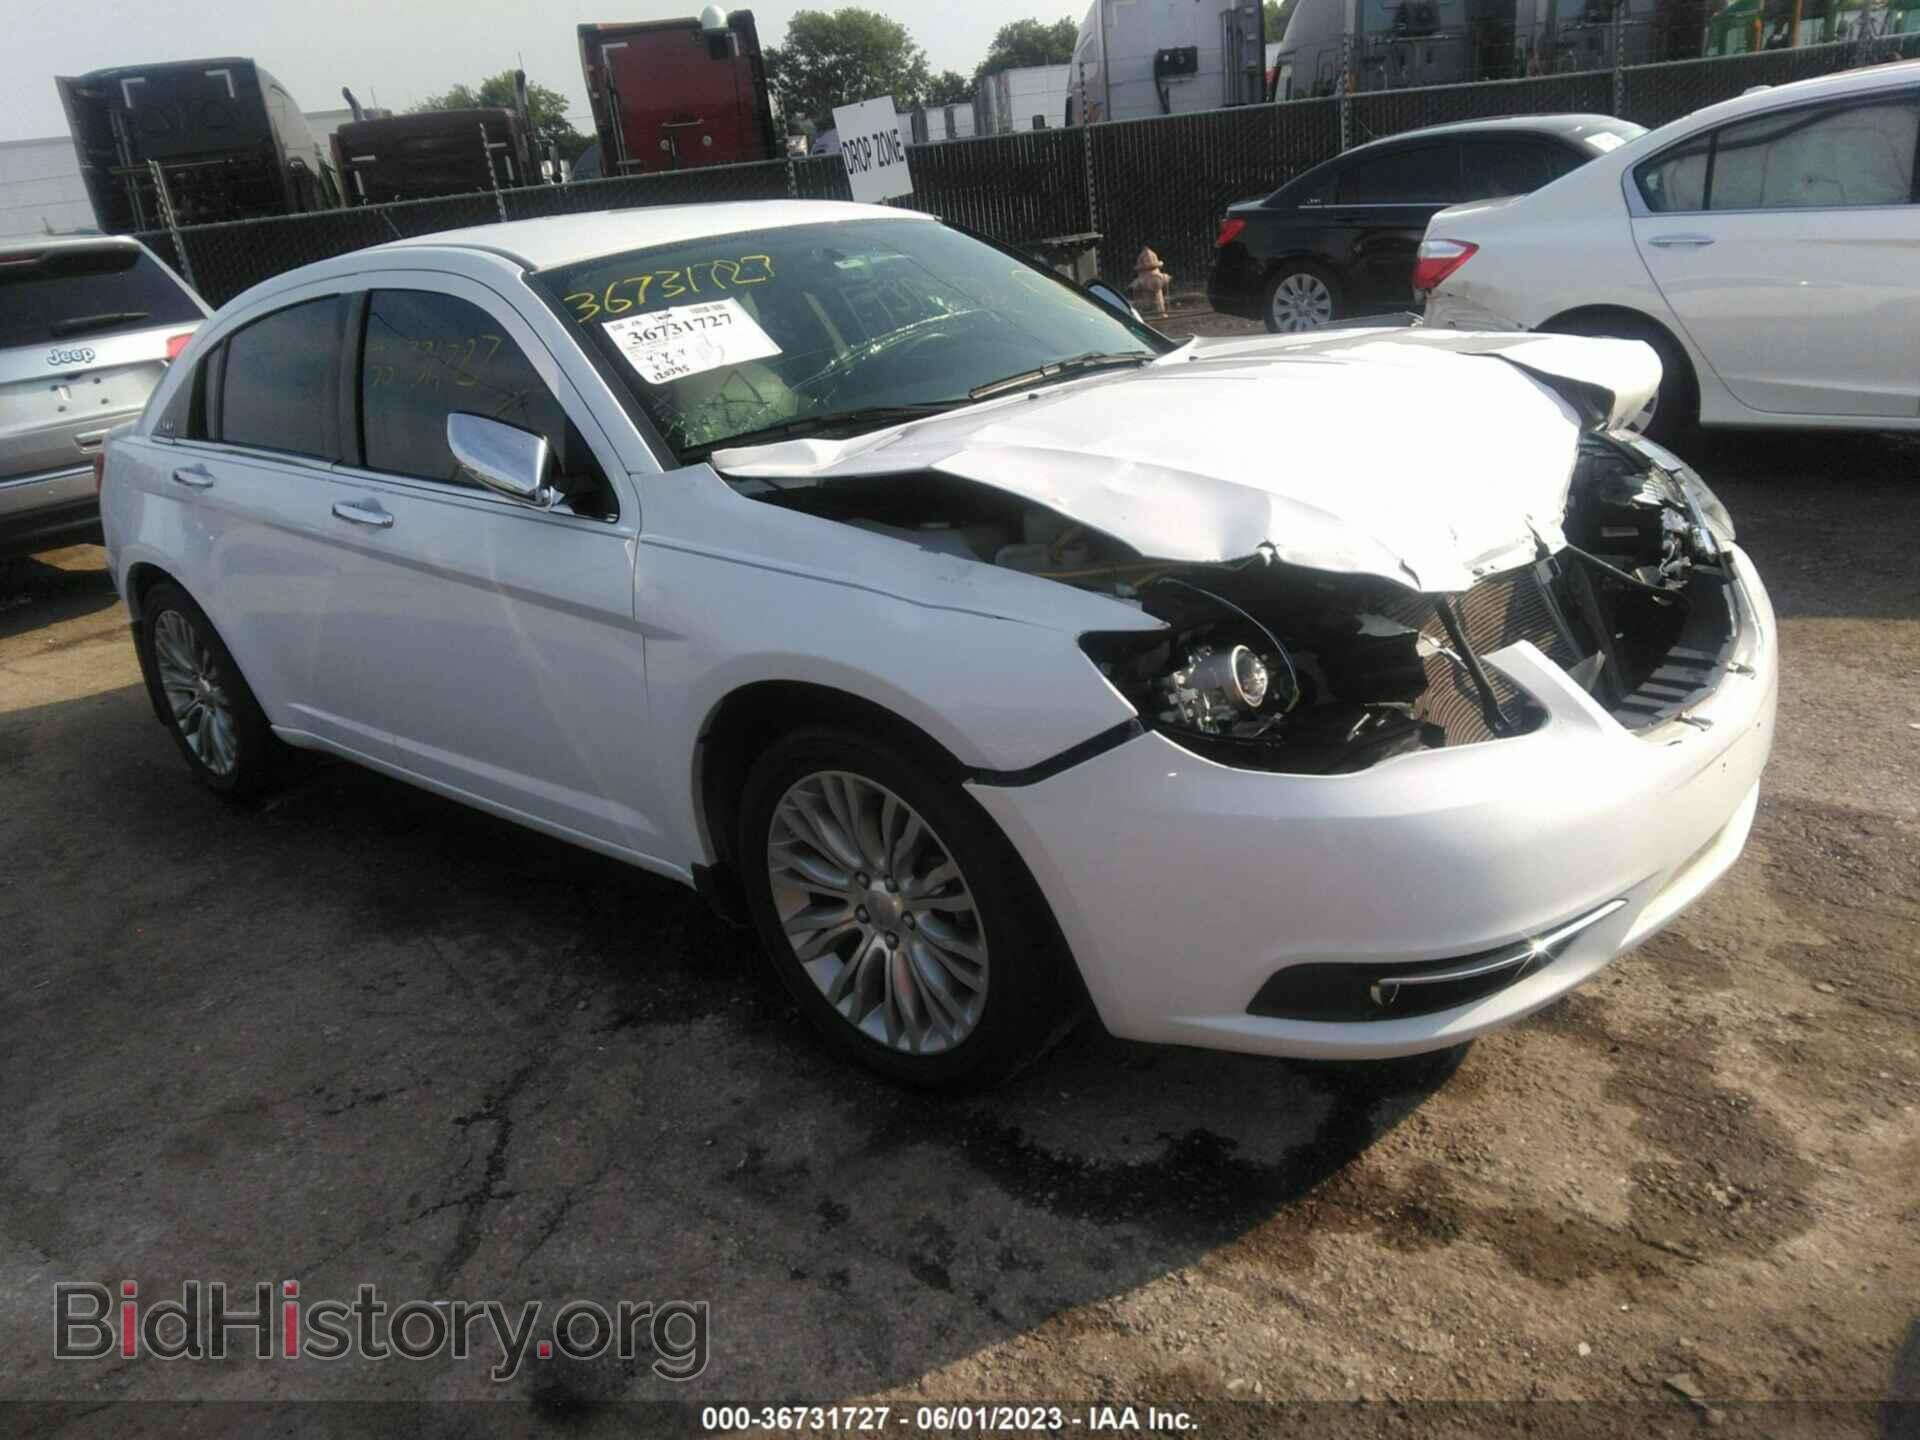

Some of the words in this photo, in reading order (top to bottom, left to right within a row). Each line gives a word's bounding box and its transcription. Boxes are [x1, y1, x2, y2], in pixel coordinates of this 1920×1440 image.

[841, 135, 872, 174] DROP
[872, 128, 904, 167] ZONE
[627, 313, 732, 345] 36731727
[46, 347, 95, 366] Jeep
